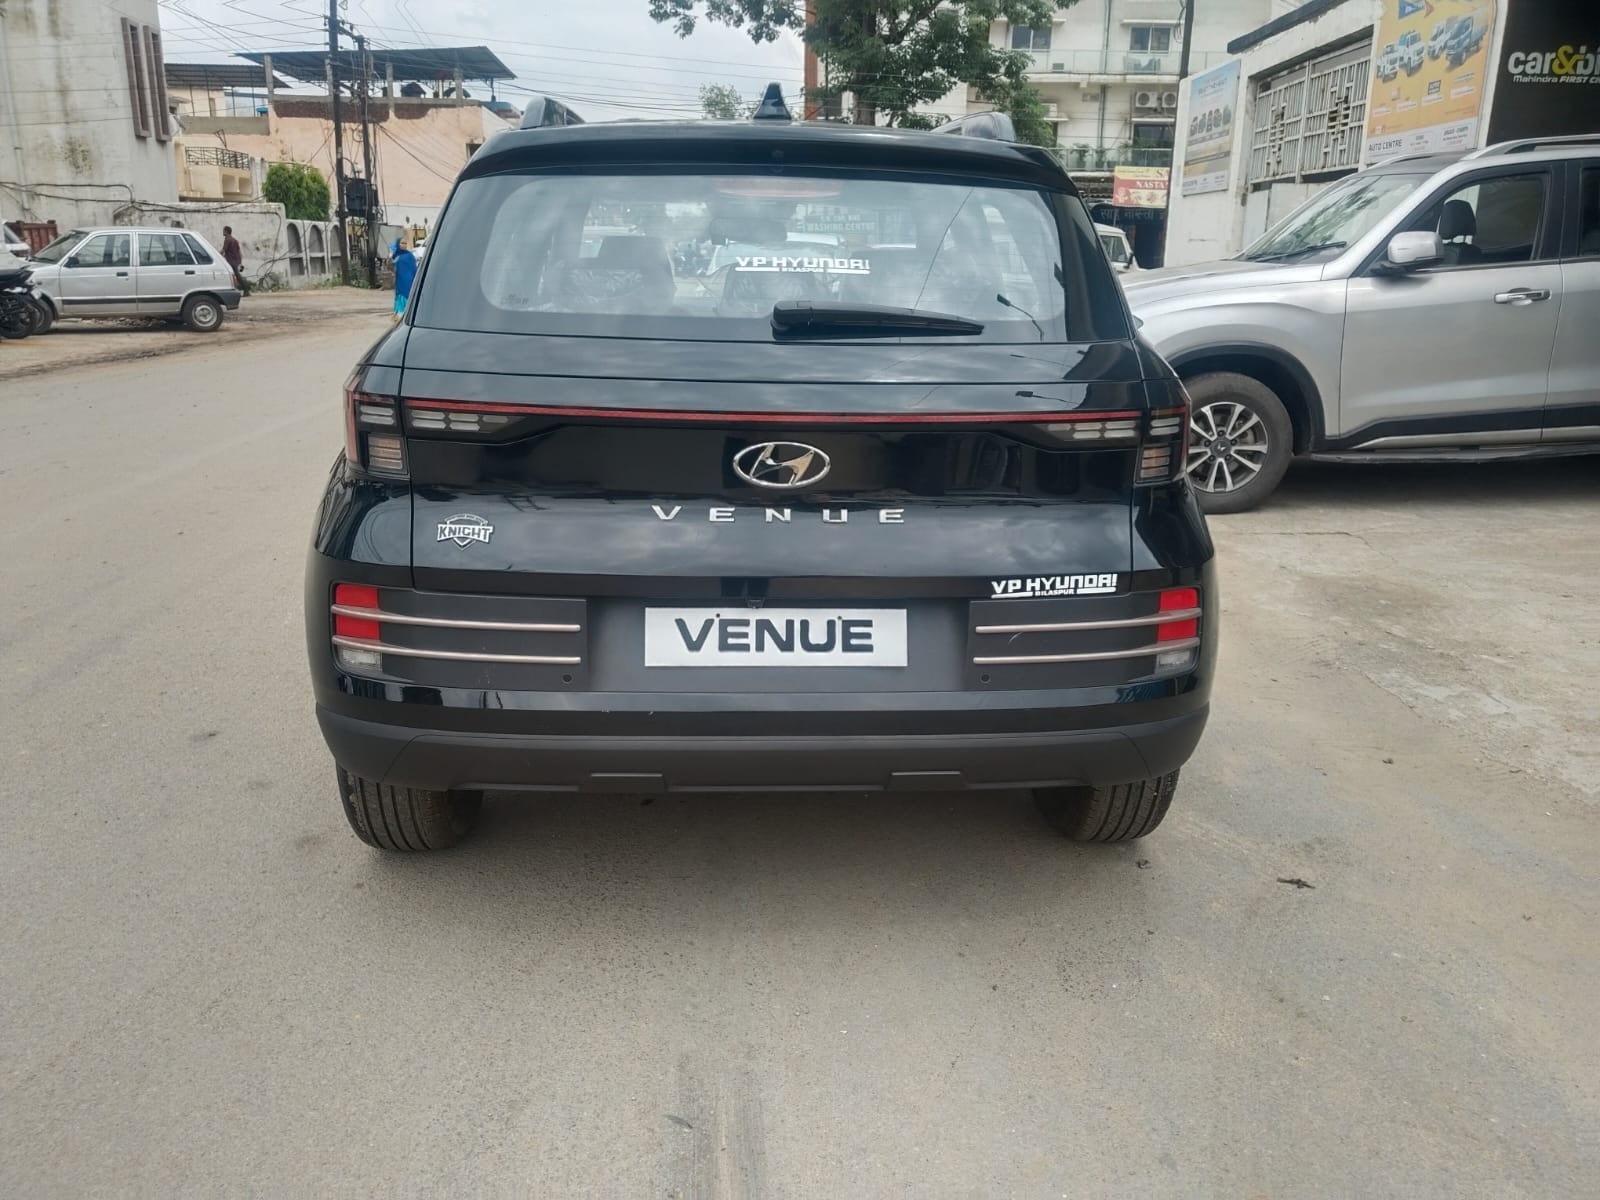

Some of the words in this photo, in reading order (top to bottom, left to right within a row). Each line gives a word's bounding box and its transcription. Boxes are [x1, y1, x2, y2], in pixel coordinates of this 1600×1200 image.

[1513, 75, 1557, 83] Mahindra
[1559, 76, 1589, 84] FIRST
[1368, 142, 1382, 152] AUTO
[1383, 139, 1402, 150] CENTRE
[735, 256, 767, 267] VP
[772, 256, 870, 270] HYUNDAI
[651, 505, 905, 524] VENUE
[437, 524, 494, 543] KNIGHT
[991, 579, 1022, 594] VP
[1026, 573, 1118, 592] HYUNDAI
[1034, 588, 1075, 597] BILASPUR
[674, 617, 875, 653] VENUE
